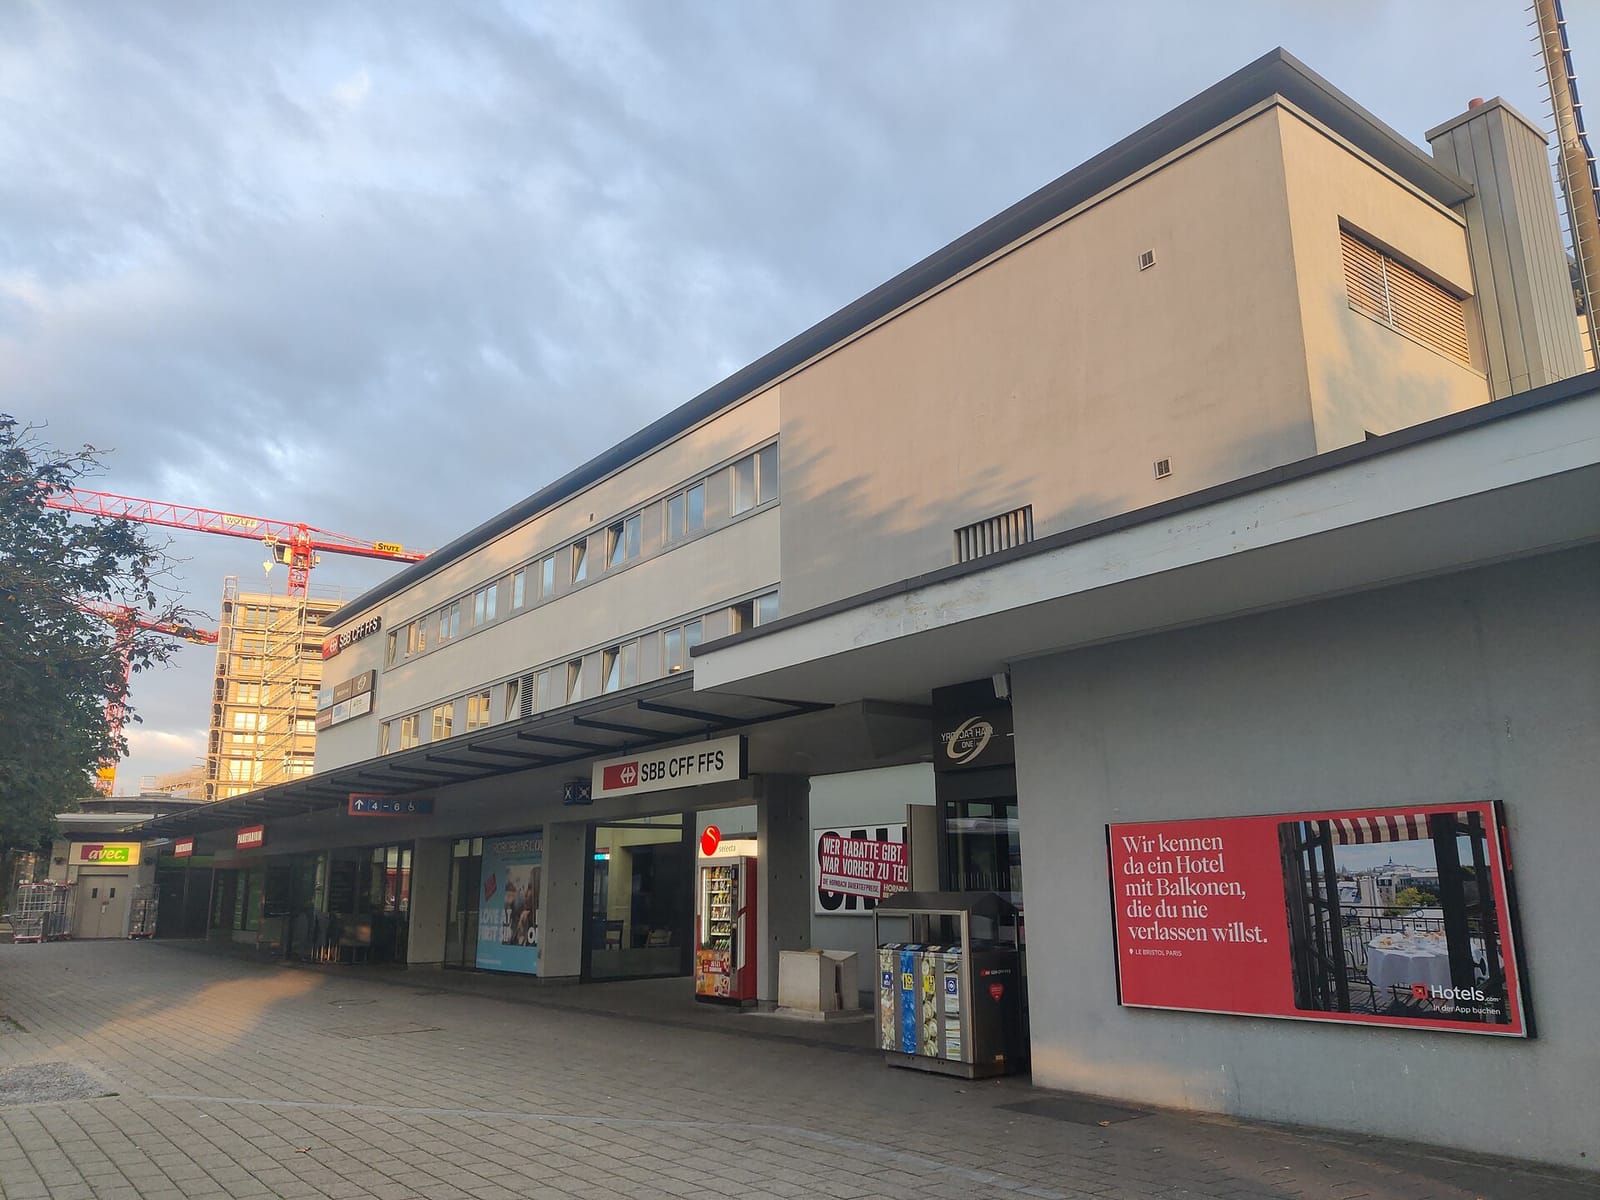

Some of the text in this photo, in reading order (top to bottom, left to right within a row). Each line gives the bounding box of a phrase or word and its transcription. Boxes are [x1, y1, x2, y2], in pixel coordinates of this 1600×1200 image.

[339, 629, 352, 648] SBB
[641, 750, 724, 782] SBB CFF FFS
[371, 802, 378, 810] 4
[823, 837, 903, 864] WER RABATTE GIBT,
[1121, 833, 1223, 854] Wir kennen
[822, 855, 839, 873] WAR
[842, 858, 875, 879] VORHER
[877, 862, 889, 880] ZU
[1123, 853, 1225, 875] da ein Hotel
[1125, 876, 1246, 900] mit Balkonen,
[1126, 899, 1208, 918] die du nie
[1128, 920, 1268, 944] verlassen willst.
[1441, 1005, 1454, 1013] der
[1455, 1005, 1471, 1014] App
[1472, 1006, 1501, 1015] buchen
